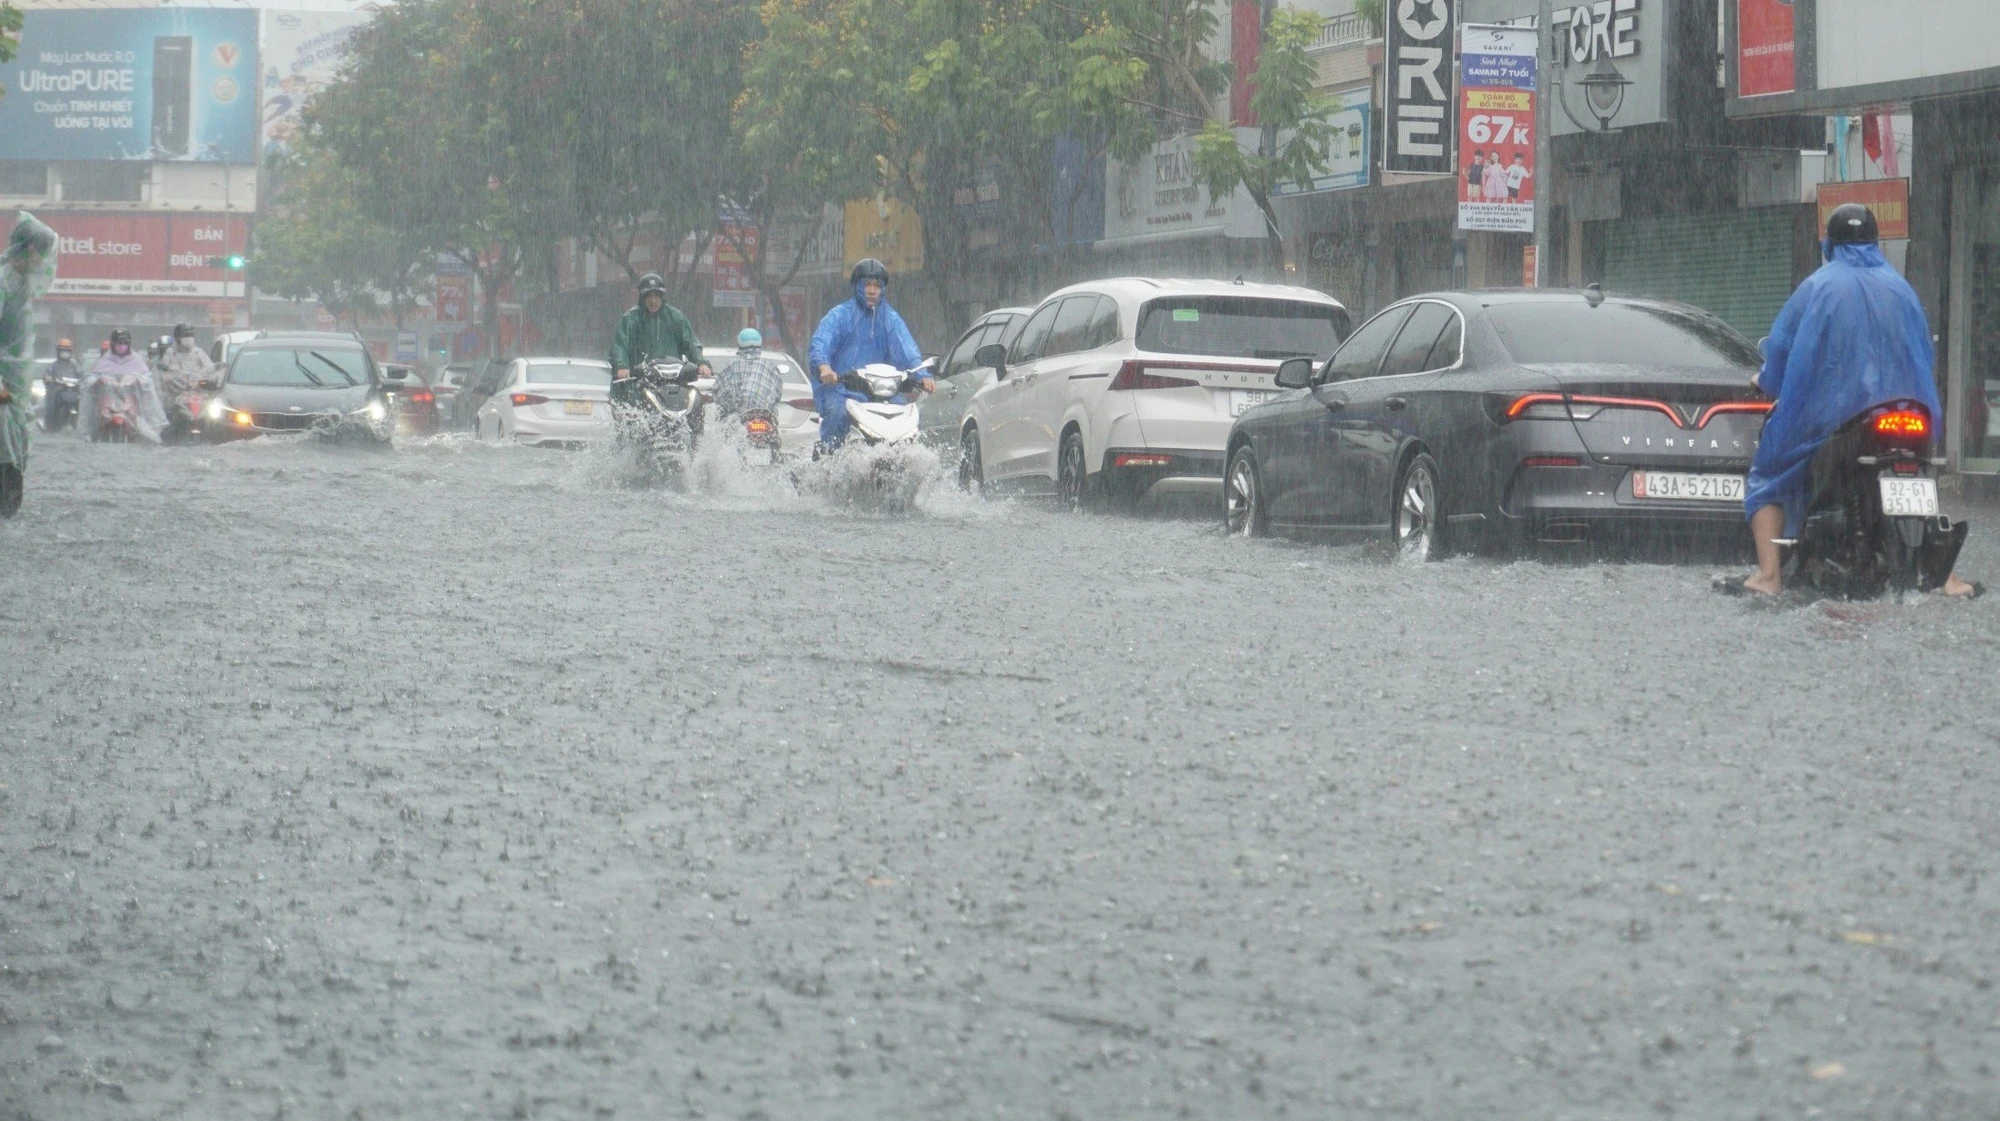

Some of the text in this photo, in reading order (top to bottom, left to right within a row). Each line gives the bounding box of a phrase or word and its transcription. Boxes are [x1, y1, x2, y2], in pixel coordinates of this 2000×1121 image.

[1533, 0, 1636, 63] TORE
[1480, 57, 1497, 66] Sinh
[1468, 67, 1529, 77] SAVANI 7 TUỔI
[19, 68, 135, 92] UltraPURE
[1483, 92, 1516, 102] TOÀN BỘ
[1492, 101, 1507, 109] TRẺ
[55, 113, 133, 131] UỐNG TẠI VÒI
[1460, 203, 1469, 211] SỐ
[1481, 204, 1505, 212] NGUYỄN
[194, 226, 223, 241] BÁN
[98, 241, 143, 256] store
[170, 251, 203, 269] ĐIỆN
[1648, 475, 1742, 498] 43A-521.67
[1890, 481, 1926, 497] 92-G1
[1886, 497, 1934, 514] 351.19
